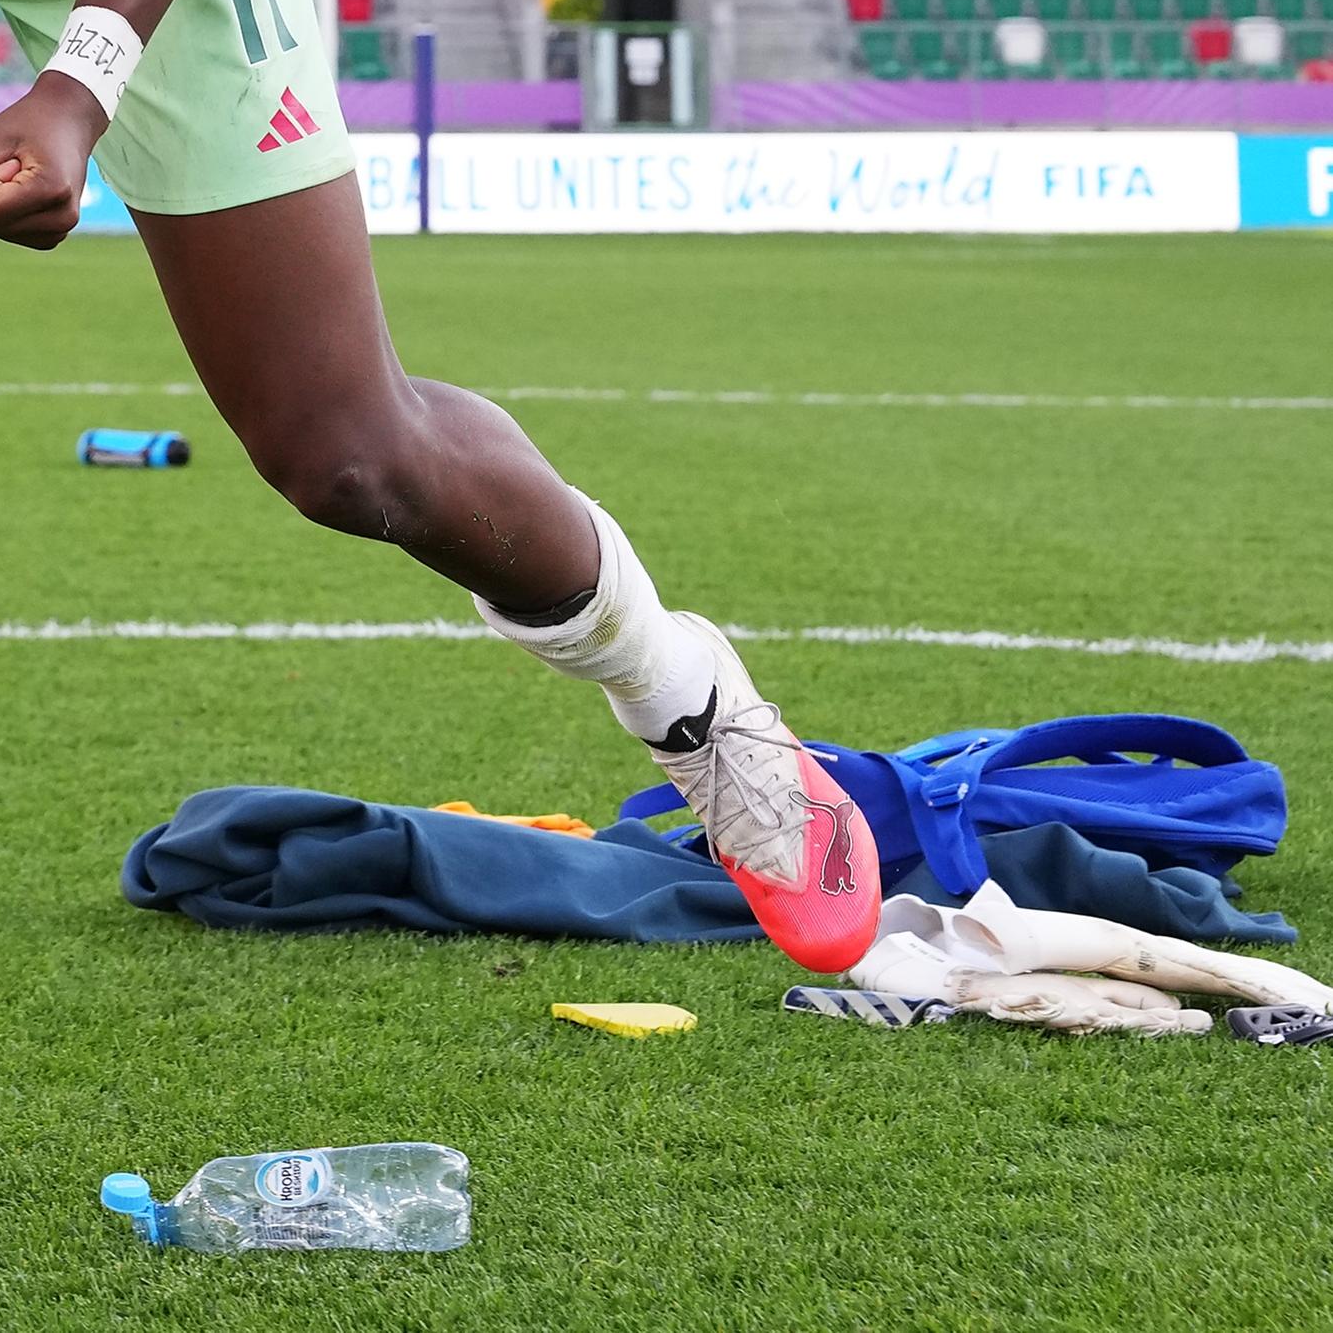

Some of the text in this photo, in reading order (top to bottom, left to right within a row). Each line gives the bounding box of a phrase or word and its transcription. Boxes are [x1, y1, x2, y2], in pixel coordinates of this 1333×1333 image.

[515, 155, 693, 211] UNITES
[827, 144, 1001, 217] World
[1043, 165, 1155, 198] FIFA
